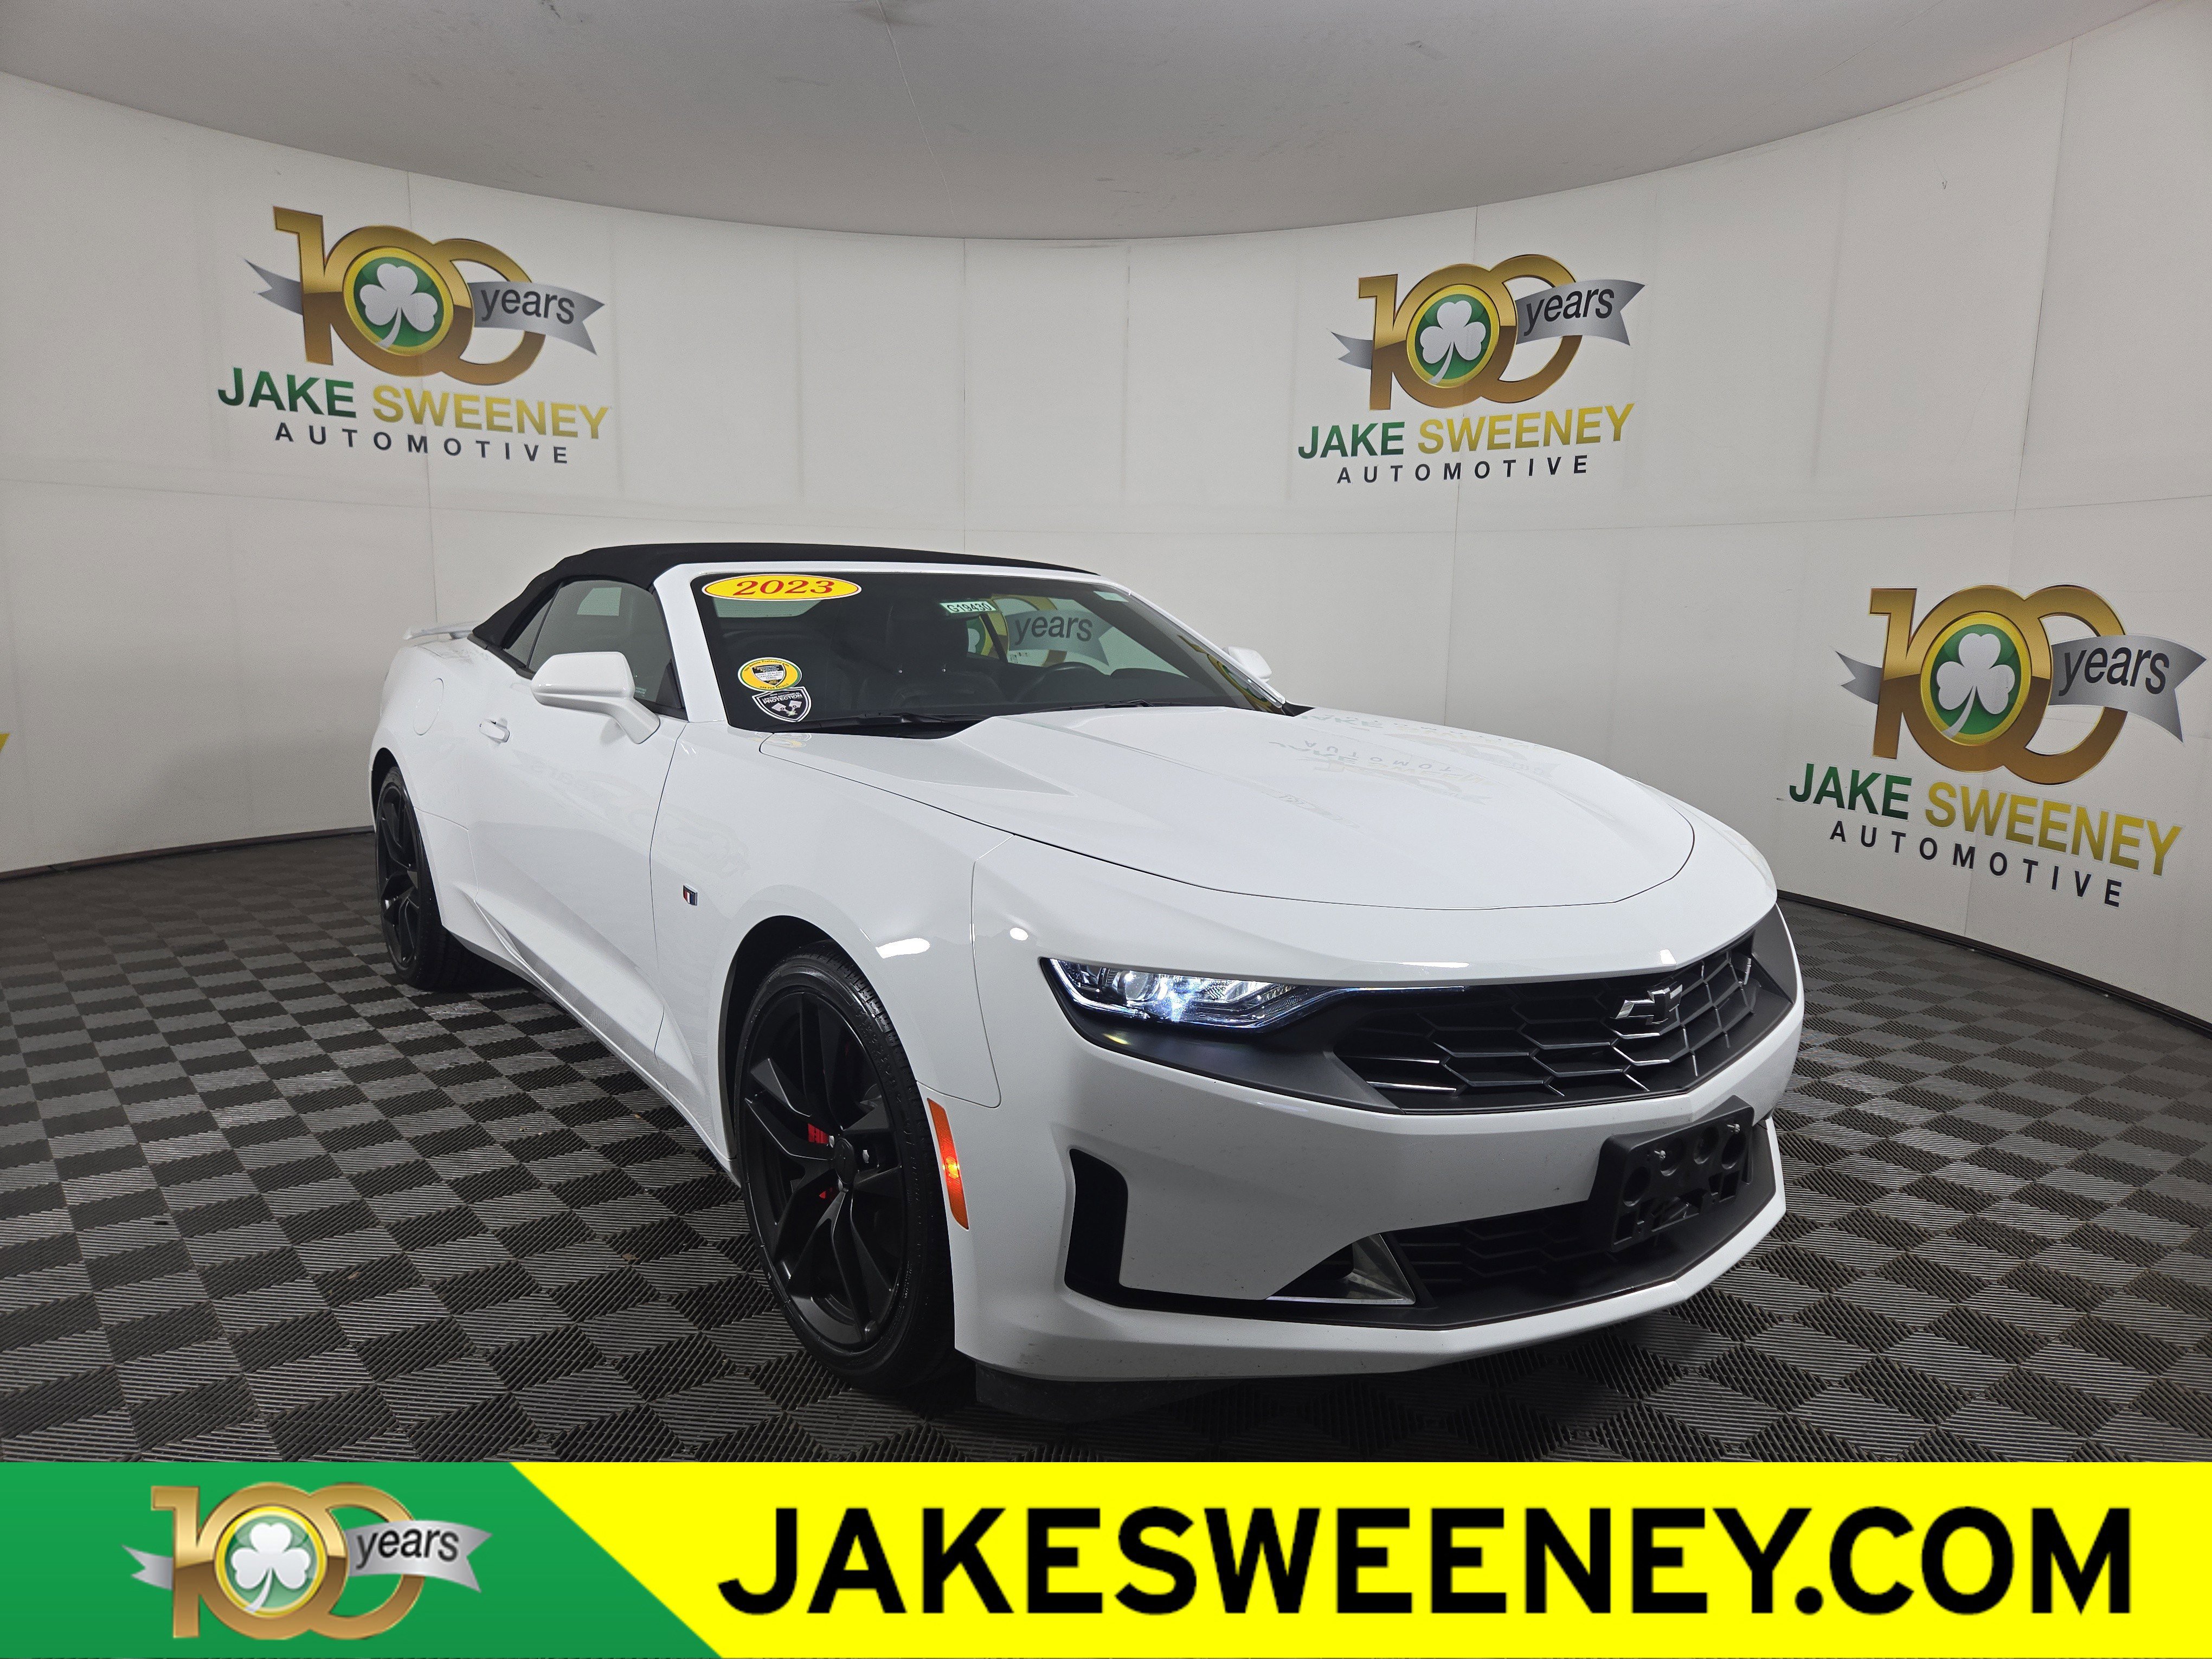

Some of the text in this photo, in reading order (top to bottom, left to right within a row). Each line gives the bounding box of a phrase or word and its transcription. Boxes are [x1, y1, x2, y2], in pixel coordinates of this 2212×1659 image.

[480, 287, 575, 325] years
[1523, 288, 1615, 336] years
[218, 367, 610, 440] JAKE SWEENEY
[275, 422, 568, 464] AUTOMOTIVE
[1298, 403, 1635, 459] JAKE SWEENEY
[1336, 454, 1587, 484] AUTOMOTIVE
[733, 580, 835, 595] 2023
[947, 603, 992, 612] G19430
[1015, 616, 1092, 645] years
[2059, 647, 2170, 696] years
[762, 693, 802, 704] PROTECTION
[1789, 763, 2182, 876] JAKE SWEENEY
[1830, 820, 2122, 908] AUTOMOTIVE
